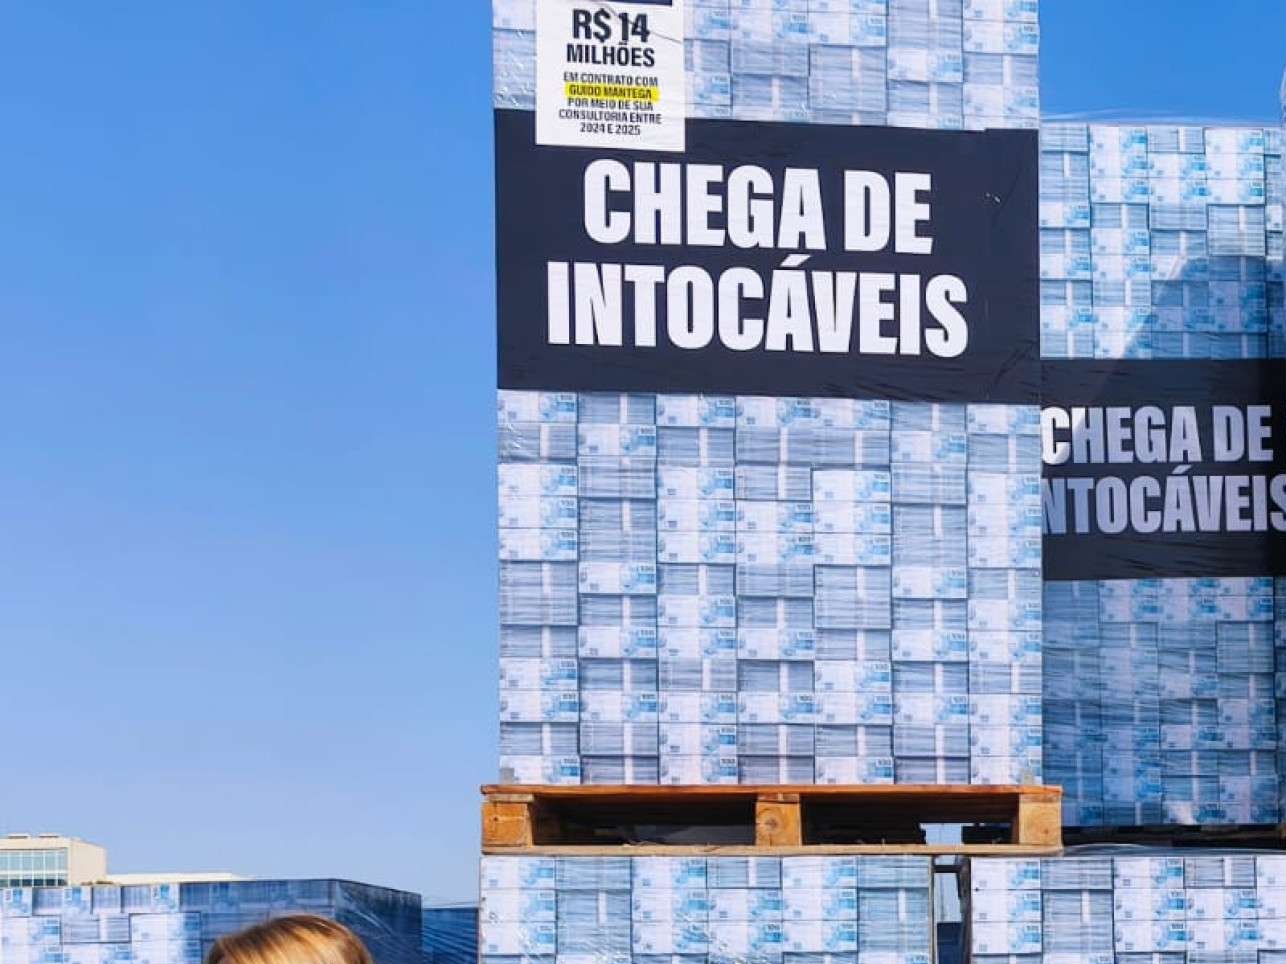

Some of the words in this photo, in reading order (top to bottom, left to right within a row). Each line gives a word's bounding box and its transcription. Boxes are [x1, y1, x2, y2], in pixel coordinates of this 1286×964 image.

[573, 8, 611, 42] R$
[618, 12, 651, 42] 14
[566, 41, 655, 67] MILHÕES
[564, 72, 578, 83] EM
[581, 73, 632, 86] CONTRATO
[635, 76, 658, 87] COM
[568, 85, 601, 96] GUIDO
[604, 86, 652, 98] MANTEGA
[567, 97, 588, 107] POR
[618, 100, 631, 110] DE
[630, 112, 662, 124] ENTRE
[615, 124, 641, 135] 2025
[584, 158, 826, 251] CHEGA
[844, 170, 933, 254] DE
[547, 254, 969, 358] INTOCÁVEIS
[1041, 405, 1202, 465] CHEGA
[1212, 404, 1274, 463] DE
